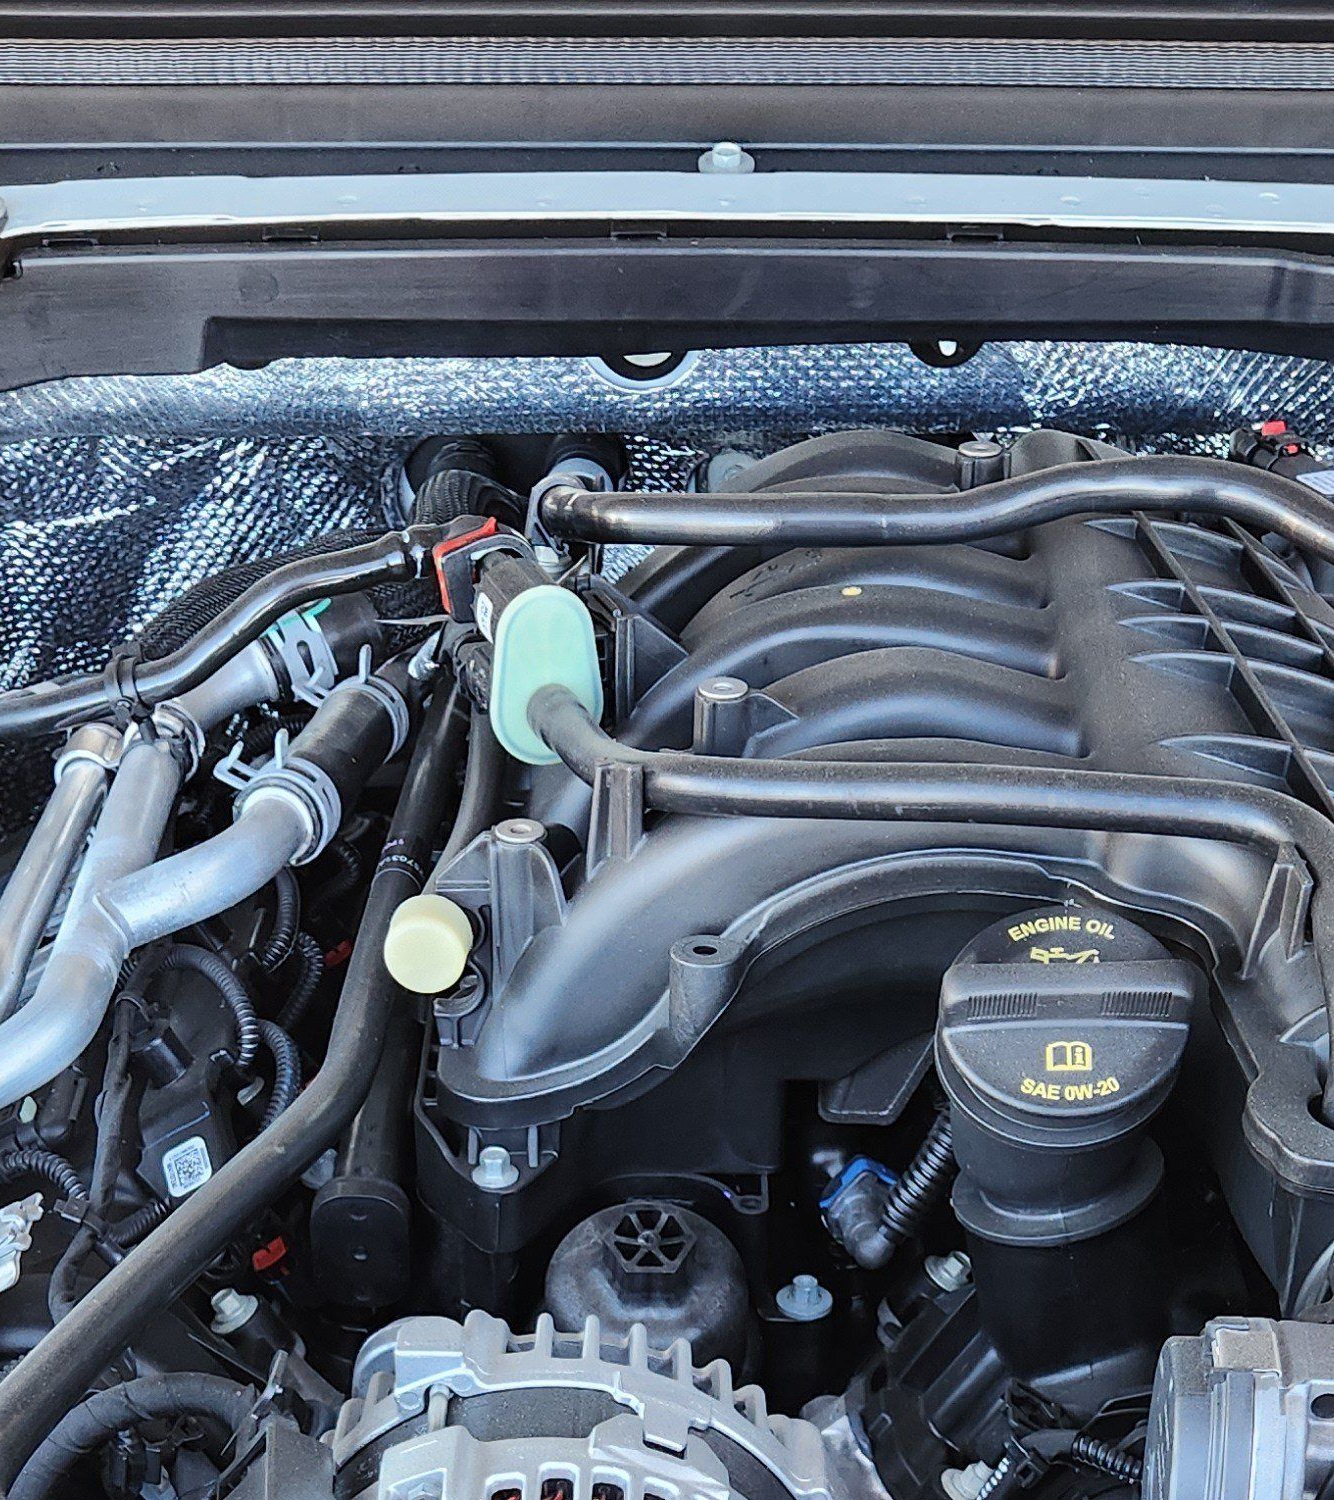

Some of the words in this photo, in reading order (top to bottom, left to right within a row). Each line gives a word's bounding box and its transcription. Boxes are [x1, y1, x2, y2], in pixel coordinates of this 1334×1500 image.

[1008, 916, 1082, 941] ENGINE
[1085, 919, 1115, 940] OIL
[1020, 1078, 1060, 1101] SAE
[1064, 1076, 1120, 1101] 0W-20
